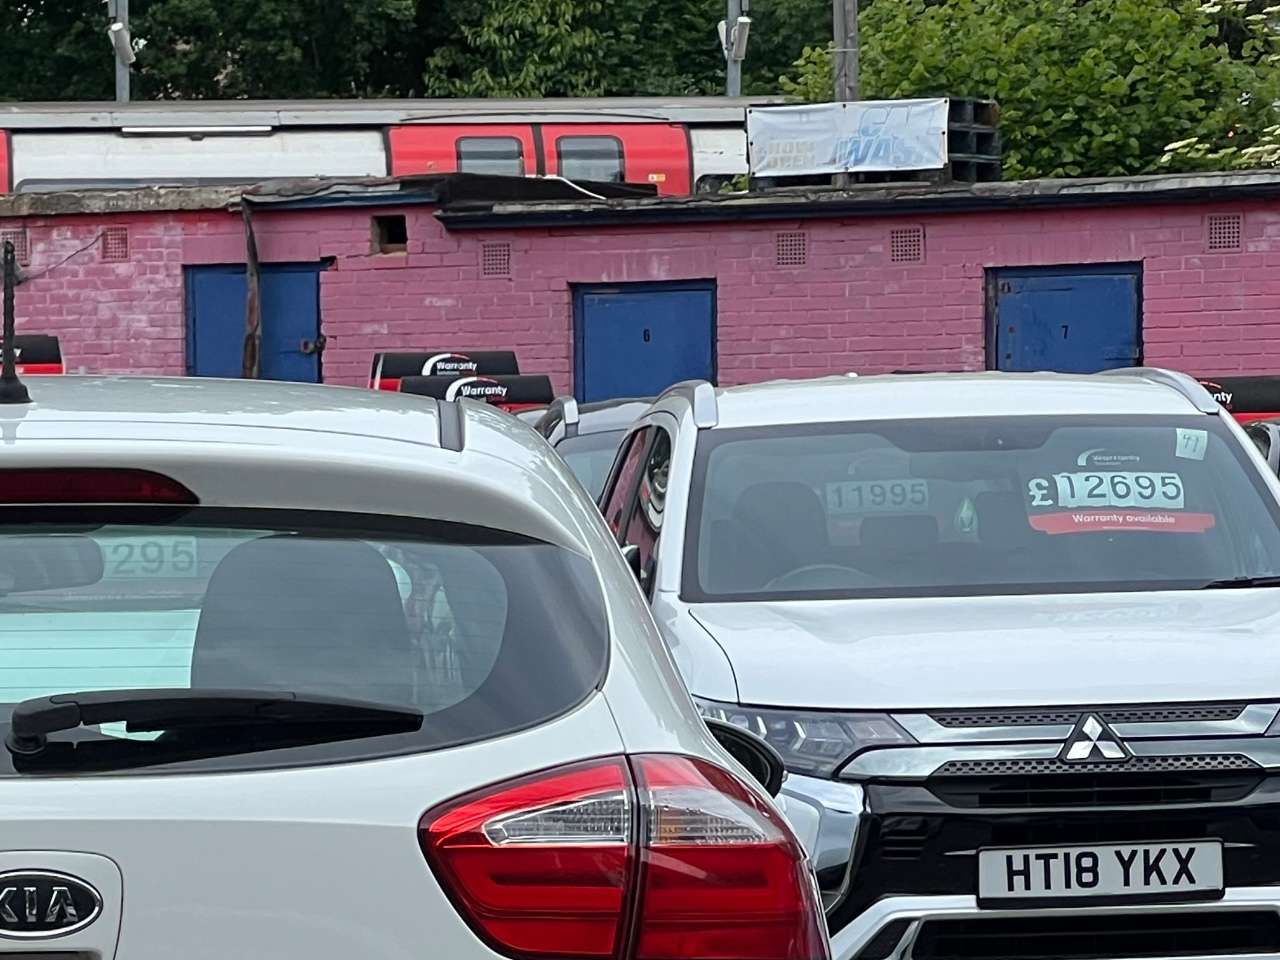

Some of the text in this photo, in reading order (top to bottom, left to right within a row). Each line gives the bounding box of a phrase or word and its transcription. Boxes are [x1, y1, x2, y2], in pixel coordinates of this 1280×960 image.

[642, 328, 651, 343] 6
[1061, 324, 1069, 340] 7
[436, 361, 478, 372] Warranty
[461, 385, 508, 397] Warranty
[831, 482, 929, 508] 11995
[1028, 474, 1181, 506] £12695
[1072, 513, 1176, 524] Warranty available
[112, 540, 194, 573] 295
[1005, 847, 1197, 892] HT18 YKX
